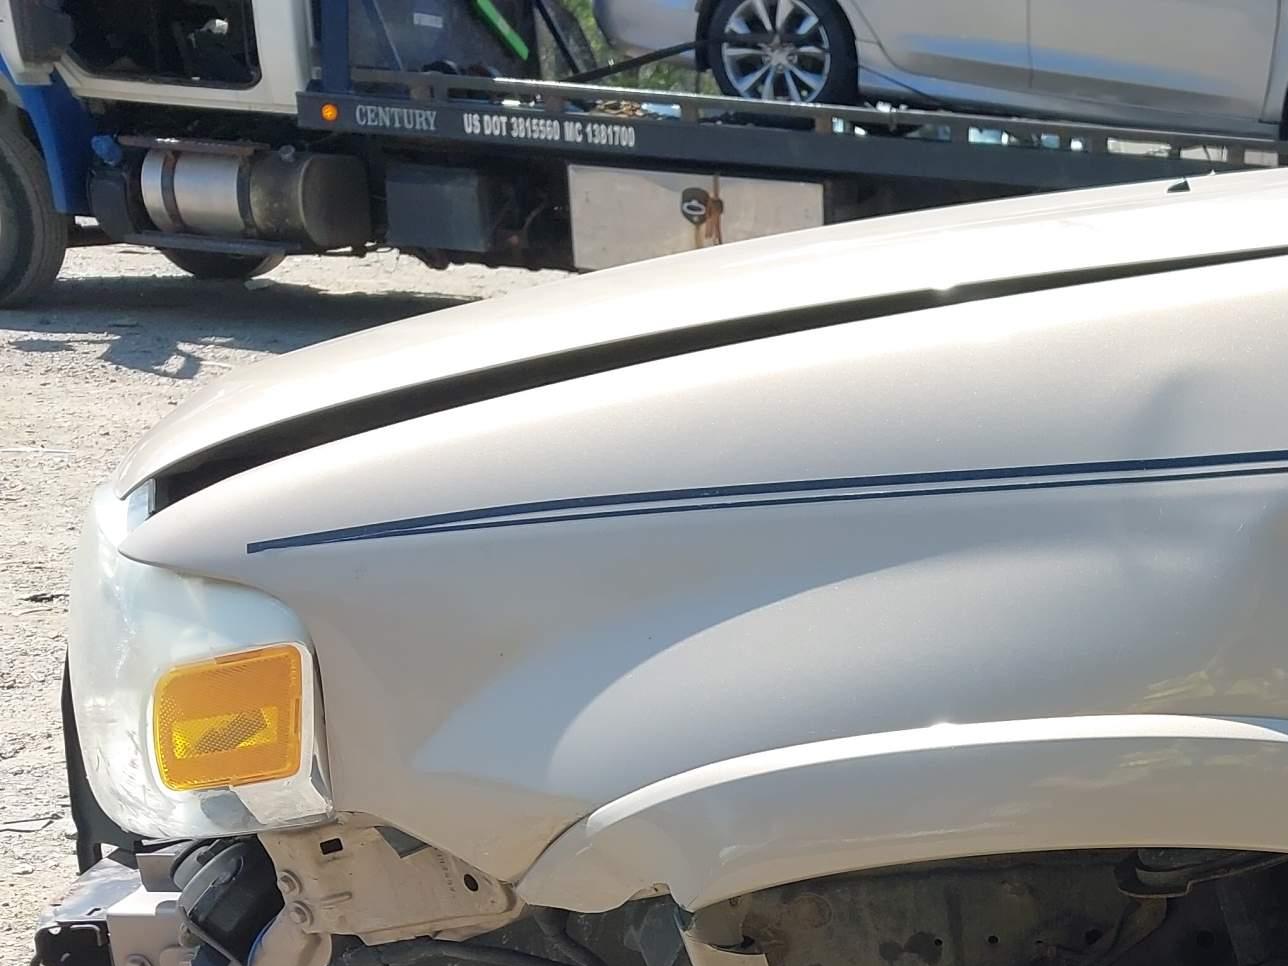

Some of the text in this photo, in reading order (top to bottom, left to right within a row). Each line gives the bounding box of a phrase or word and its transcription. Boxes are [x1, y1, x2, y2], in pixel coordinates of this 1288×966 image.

[355, 104, 437, 130] CENTURY
[463, 113, 636, 147] US DOT 3815560 MC 1381700
